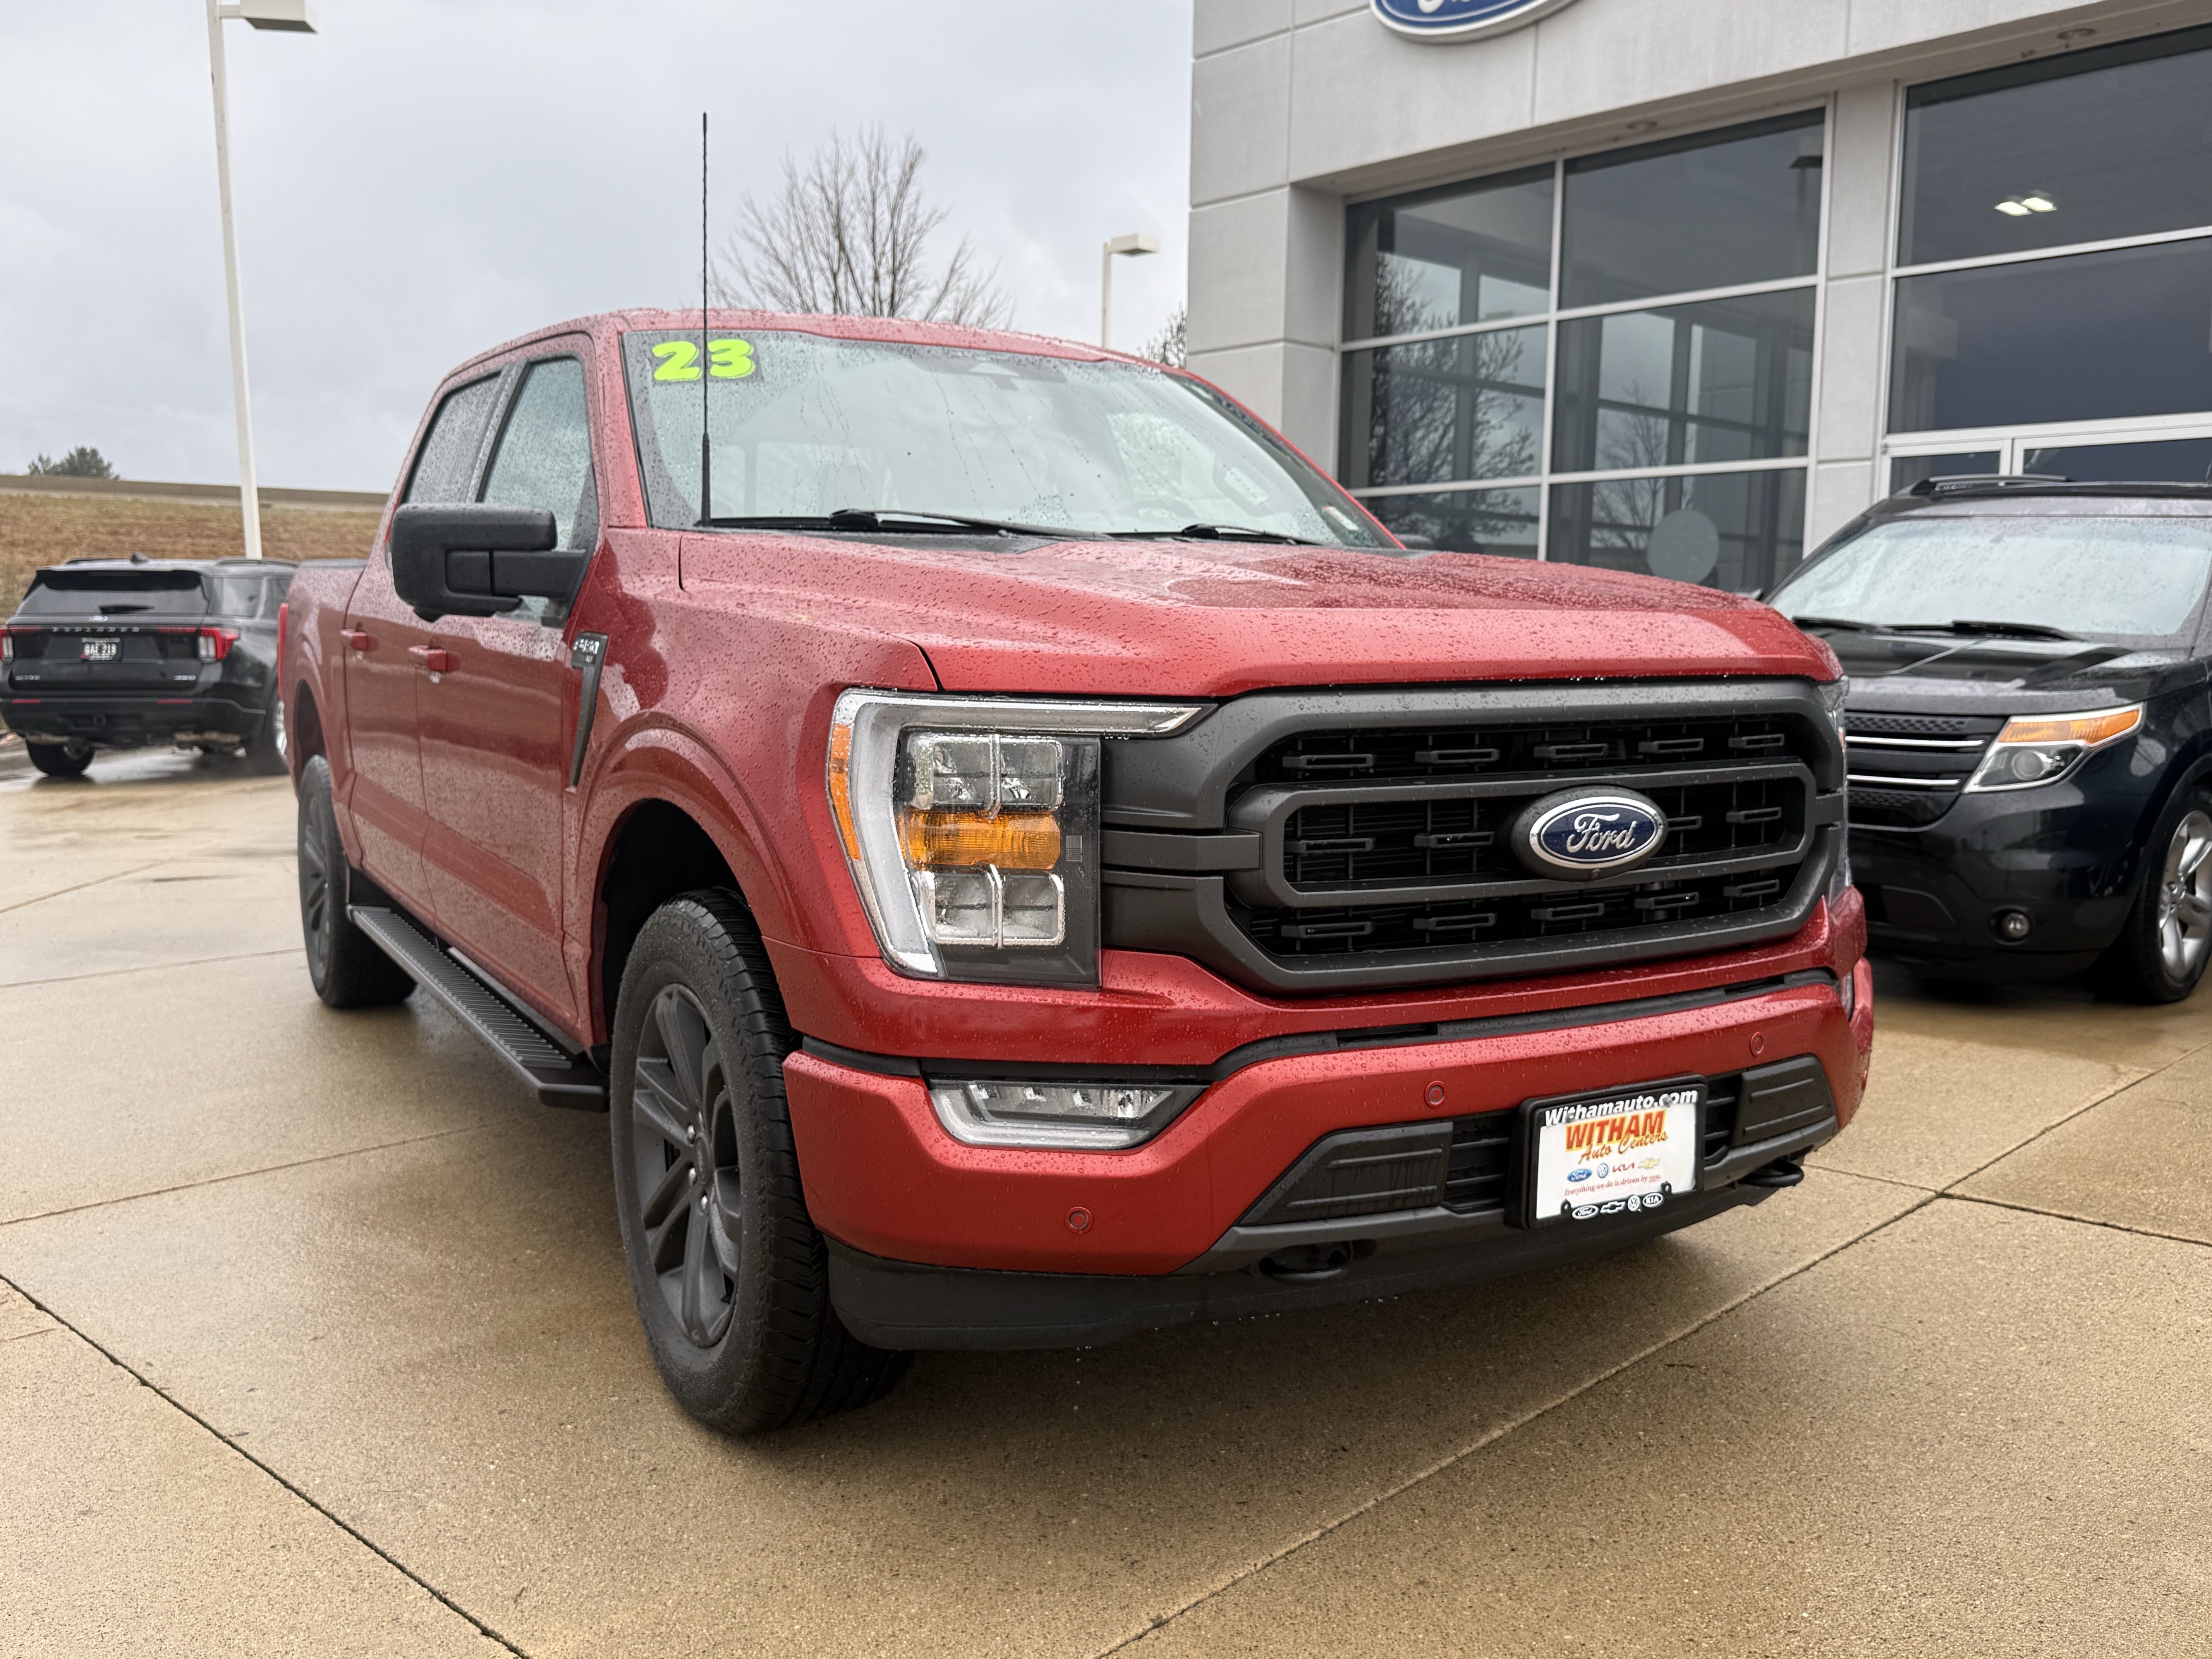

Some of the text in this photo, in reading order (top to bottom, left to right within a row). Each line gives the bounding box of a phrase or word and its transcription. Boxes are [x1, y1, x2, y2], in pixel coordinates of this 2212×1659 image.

[652, 338, 755, 382] 23
[1566, 813, 1638, 853] Ford
[1546, 1090, 1697, 1127] Withamauto.com
[1566, 1110, 1665, 1150] WITHAM
[1578, 1131, 1668, 1164] Auto Centers
[1564, 1185, 1595, 1196] Everything
[1641, 1175, 1648, 1183] by
